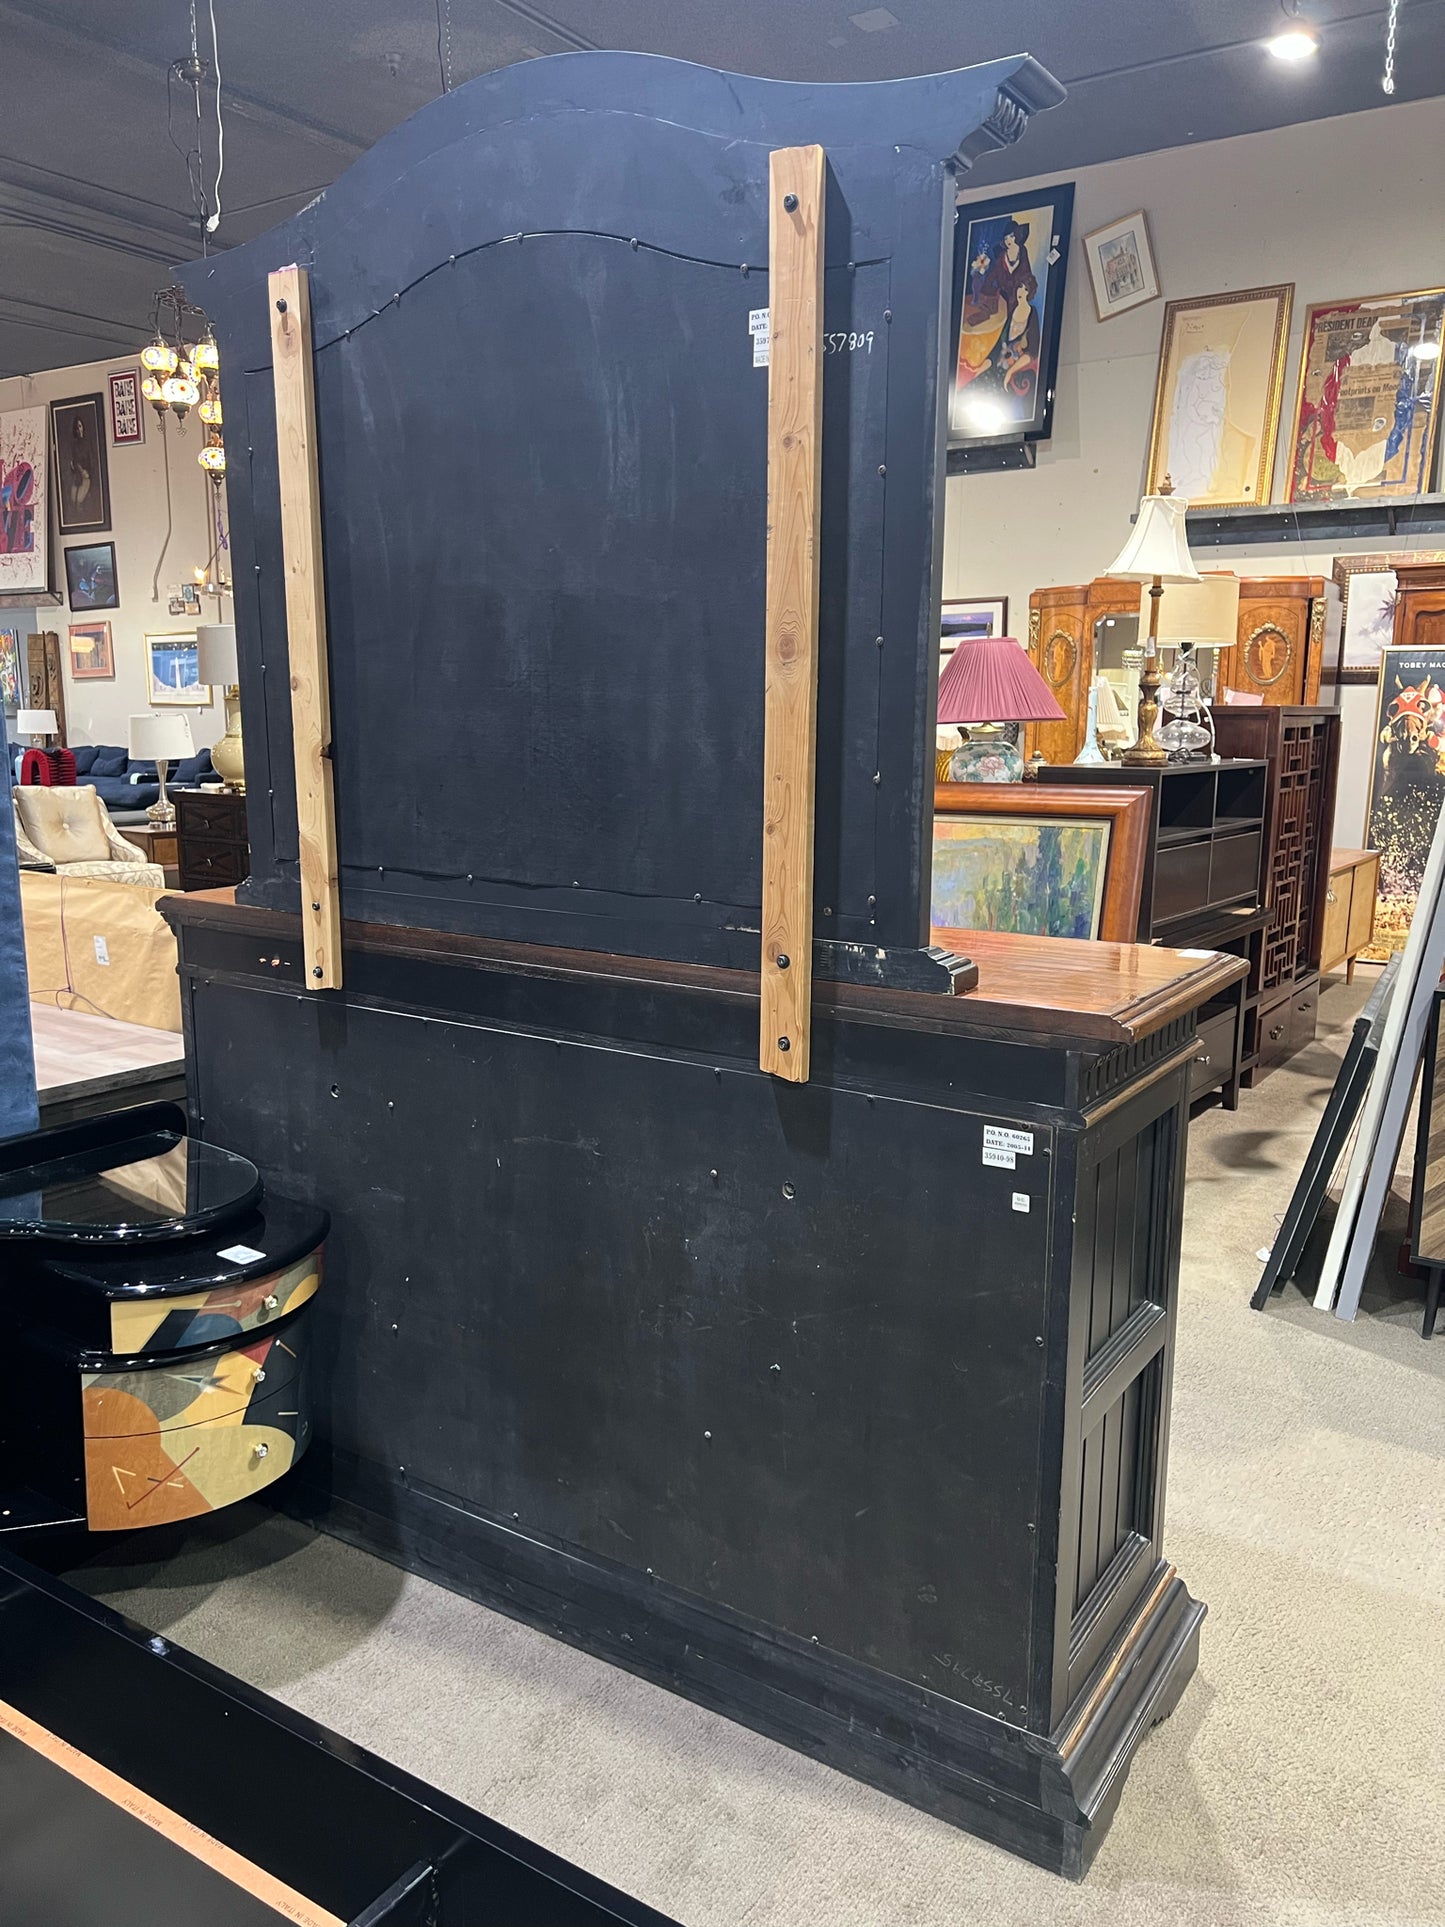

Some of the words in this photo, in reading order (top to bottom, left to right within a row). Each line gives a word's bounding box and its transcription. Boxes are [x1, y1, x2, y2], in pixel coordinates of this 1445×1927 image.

[986, 1138, 1005, 1147] DATE:
[275, 1901, 296, 1914] ITALY
[295, 1911, 305, 1920] IN
